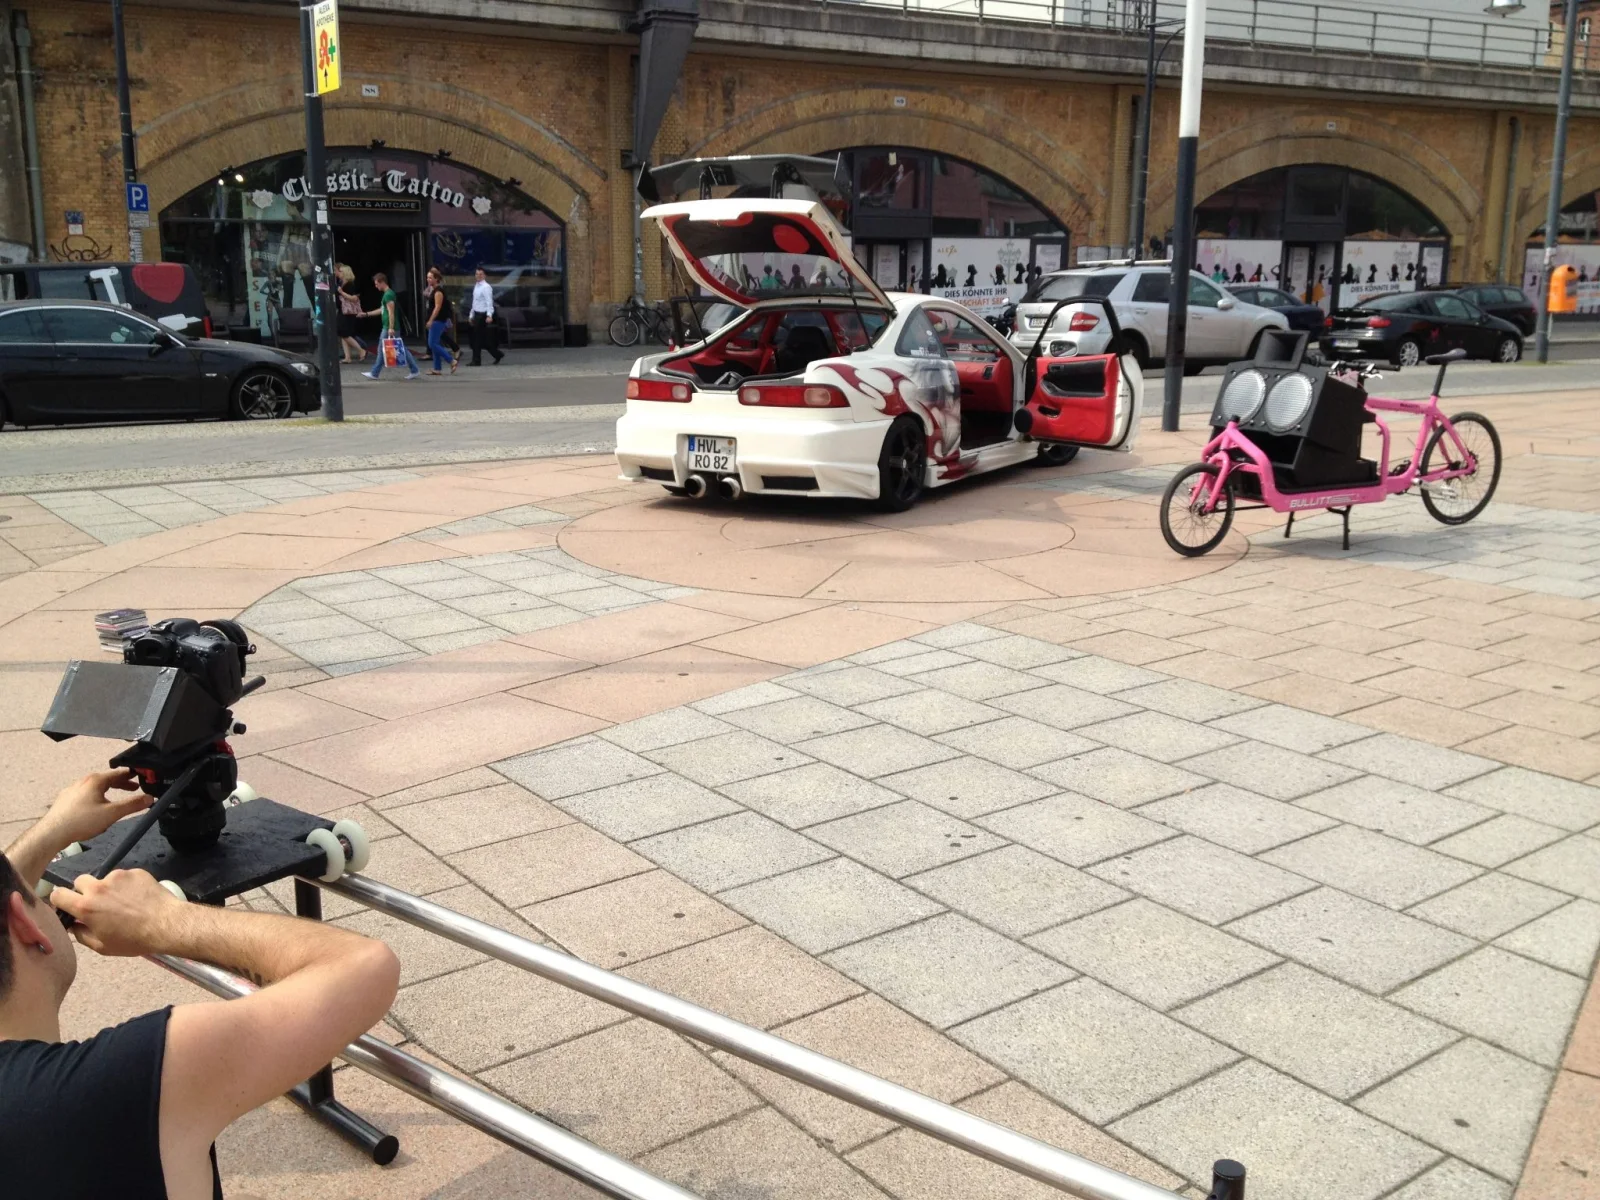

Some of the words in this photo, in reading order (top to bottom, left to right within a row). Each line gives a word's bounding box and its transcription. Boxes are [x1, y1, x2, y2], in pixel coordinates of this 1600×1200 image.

[316, 13, 334, 27] APOTHEKE
[131, 186, 144, 208] P
[944, 290, 960, 298] DIES
[962, 286, 993, 297] KÖNNTE
[698, 439, 721, 453] HVL
[695, 455, 710, 468] RO
[713, 456, 728, 470] 82
[1290, 496, 1332, 508] BULLITT
